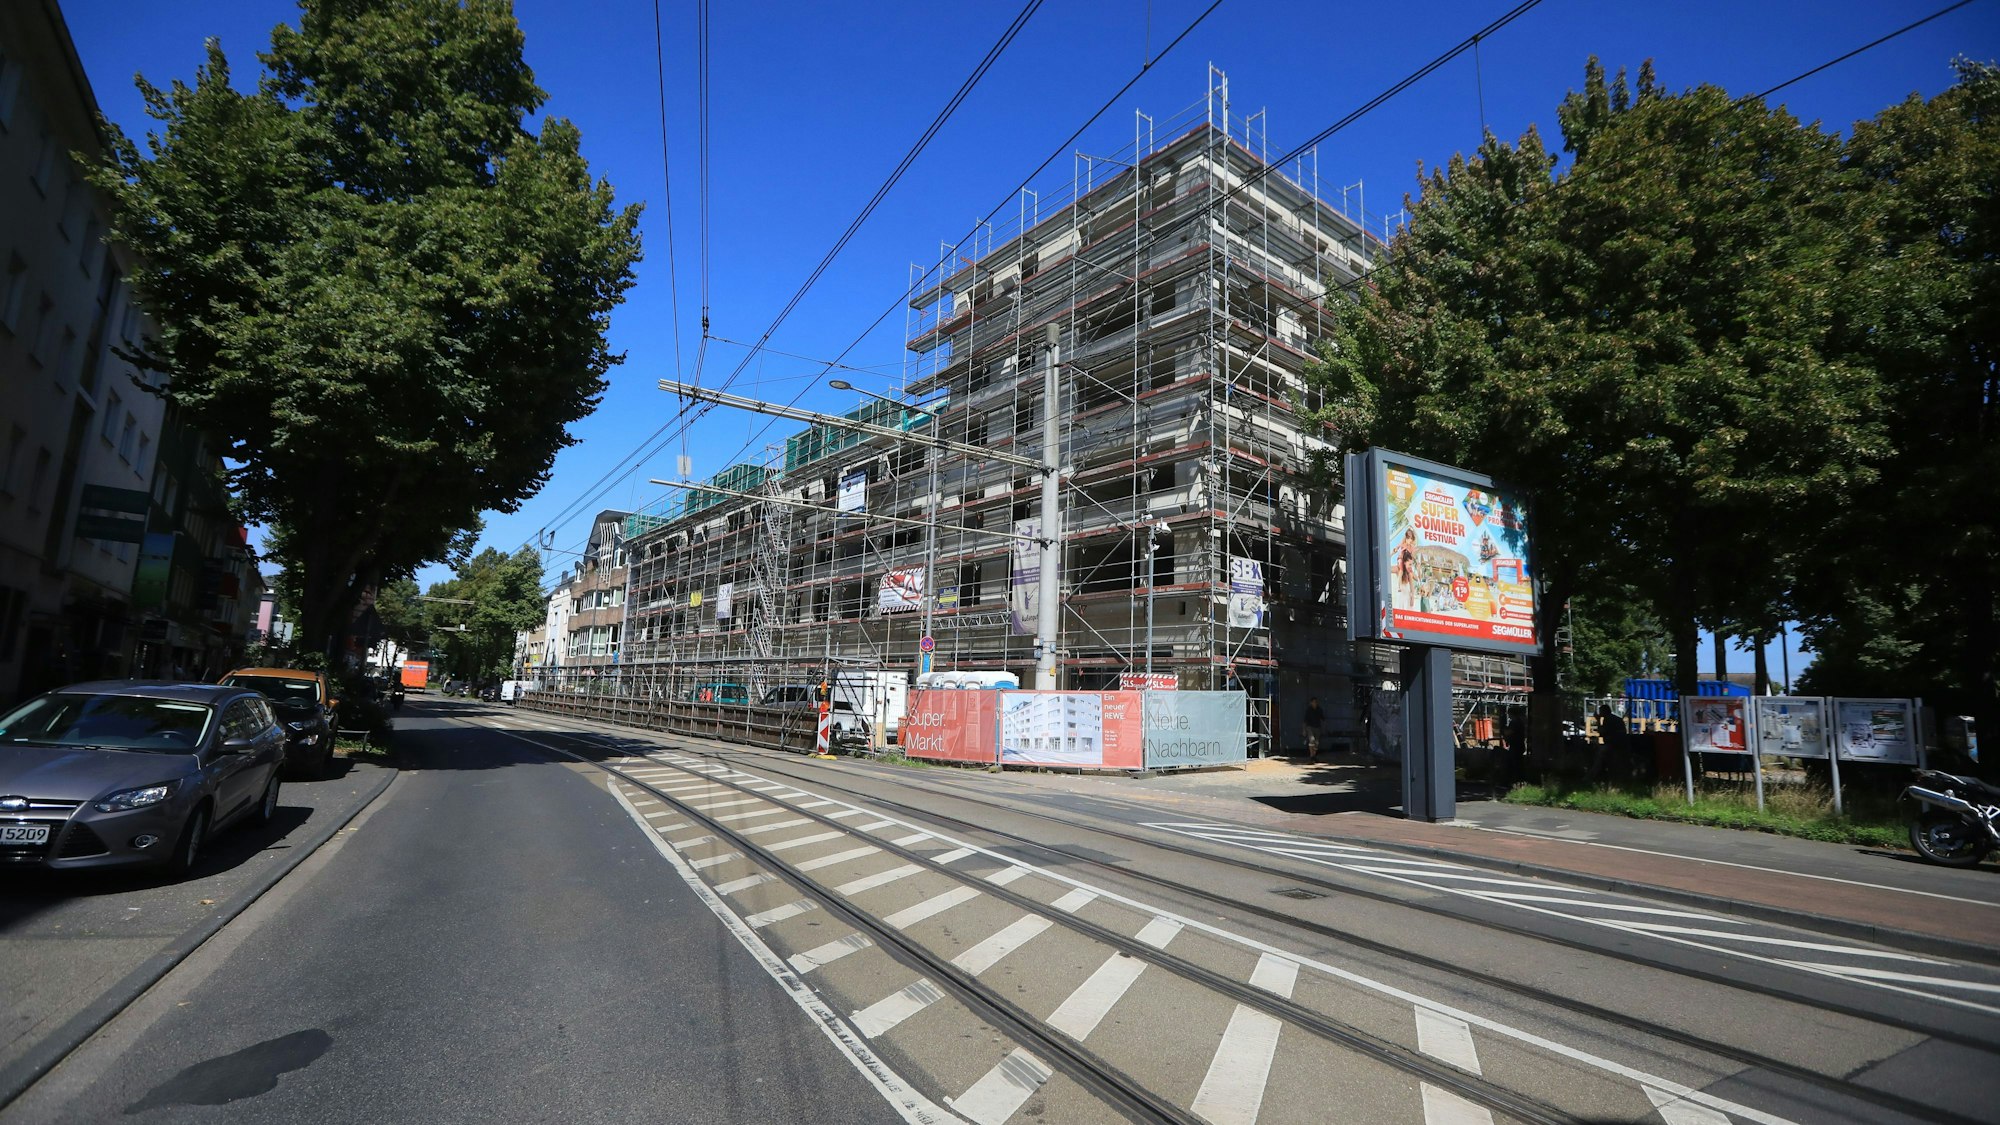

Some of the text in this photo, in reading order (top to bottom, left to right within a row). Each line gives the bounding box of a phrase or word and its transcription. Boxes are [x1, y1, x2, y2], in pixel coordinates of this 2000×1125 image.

[1421, 501, 1459, 521] SUPER
[1414, 514, 1465, 537] SOMMER
[1424, 531, 1457, 545] FESTIVAL
[1492, 624, 1533, 639] SEGMÜLLER
[1104, 693, 1115, 701] Ein
[908, 711, 946, 731] Super.
[1148, 711, 1191, 731] Neue.
[907, 732, 945, 752] Markt.
[1148, 738, 1223, 758] Nachbarn.
[6, 828, 46, 841] 5209
